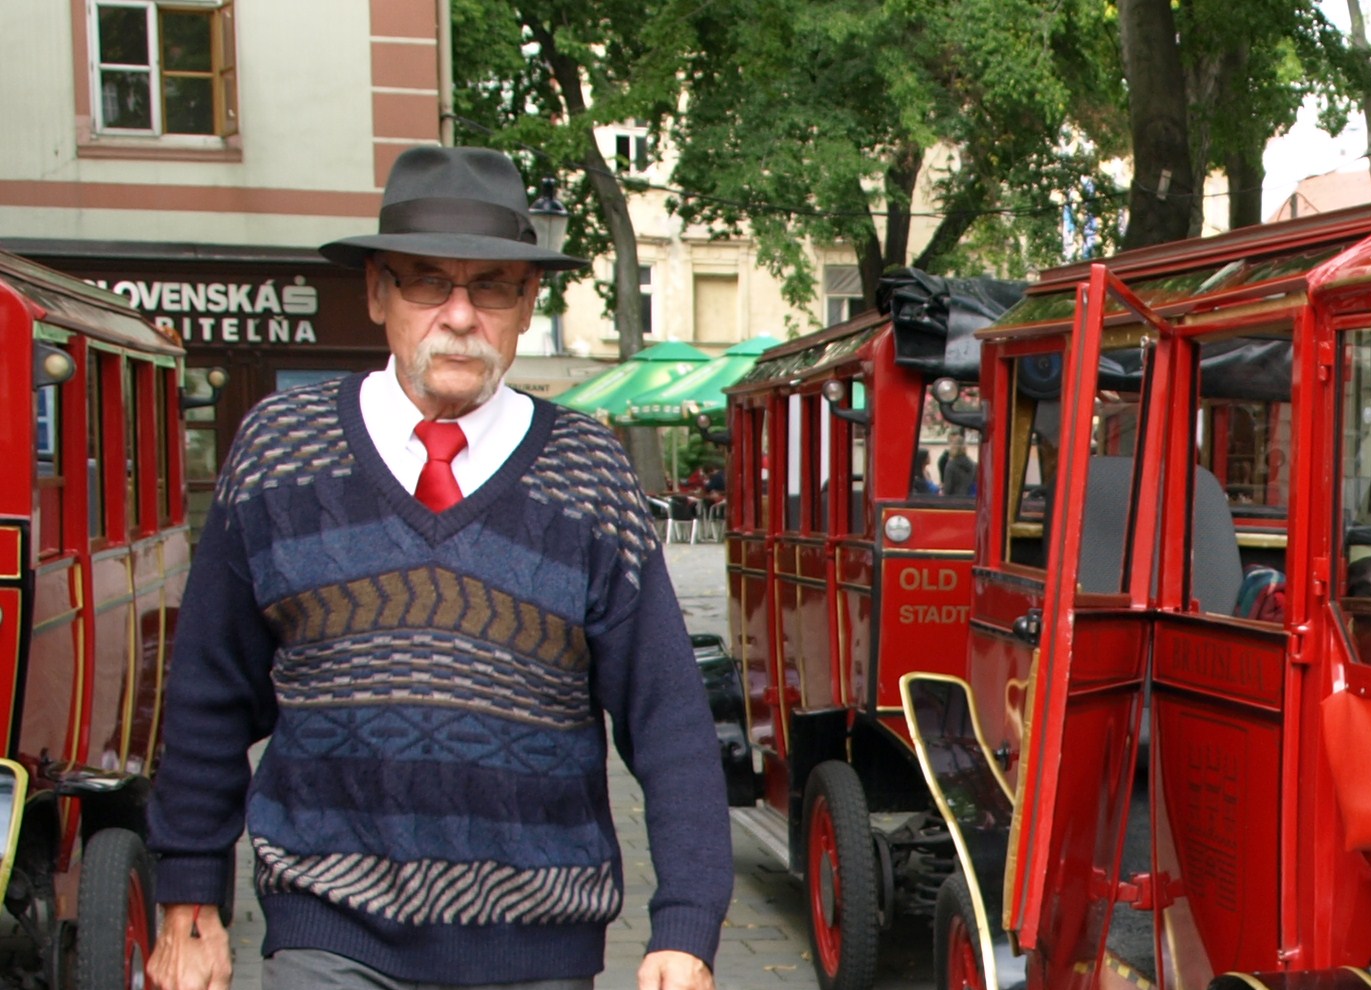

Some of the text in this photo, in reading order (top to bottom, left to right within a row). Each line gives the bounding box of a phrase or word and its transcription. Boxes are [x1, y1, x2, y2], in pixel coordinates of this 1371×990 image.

[82, 278, 282, 314] OVENSKÁ
[900, 567, 957, 591] OLD
[900, 605, 970, 624] STADT
